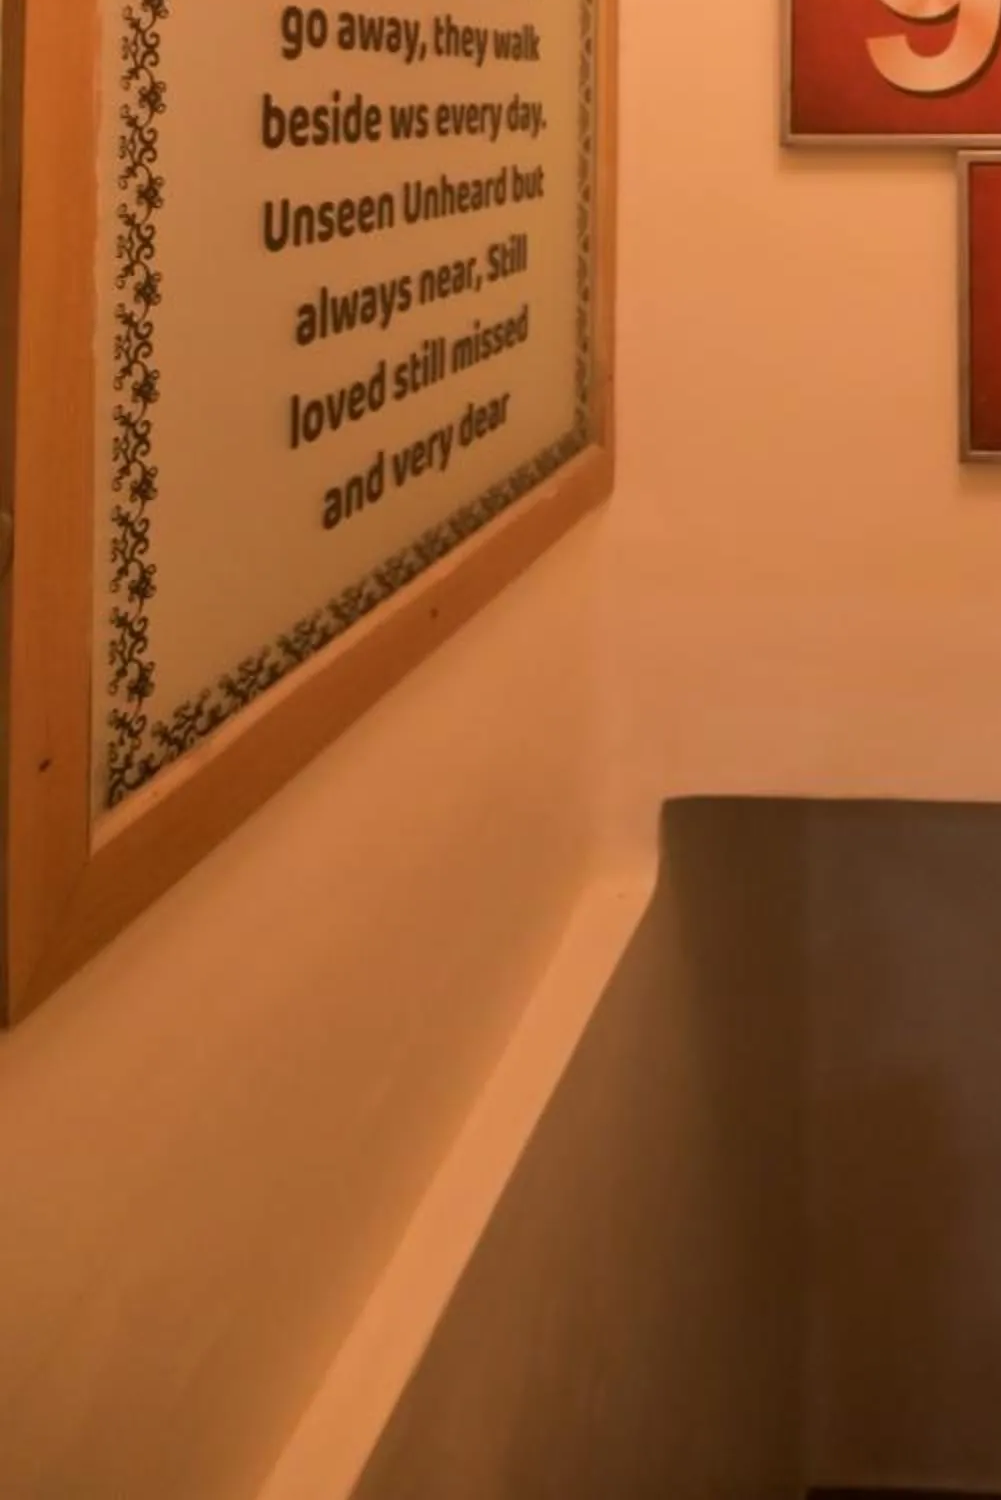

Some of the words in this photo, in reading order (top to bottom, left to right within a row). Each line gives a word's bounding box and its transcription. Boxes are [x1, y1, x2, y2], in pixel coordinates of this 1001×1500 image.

[281, 5, 328, 60] go
[337, 11, 427, 66] away,
[434, 13, 488, 68] they
[493, 23, 540, 62] walk
[261, 90, 382, 150] beside
[435, 101, 502, 143] every
[506, 93, 547, 139] day.
[263, 192, 394, 253] Unseen
[403, 166, 506, 225] Unheard
[512, 164, 544, 203] but
[295, 274, 412, 347] always
[419, 256, 483, 305] near,
[290, 359, 386, 450] loved
[392, 337, 446, 401] still
[452, 303, 528, 375] missed
[322, 450, 384, 531] and
[392, 423, 454, 489] very
[458, 392, 510, 448] dear
